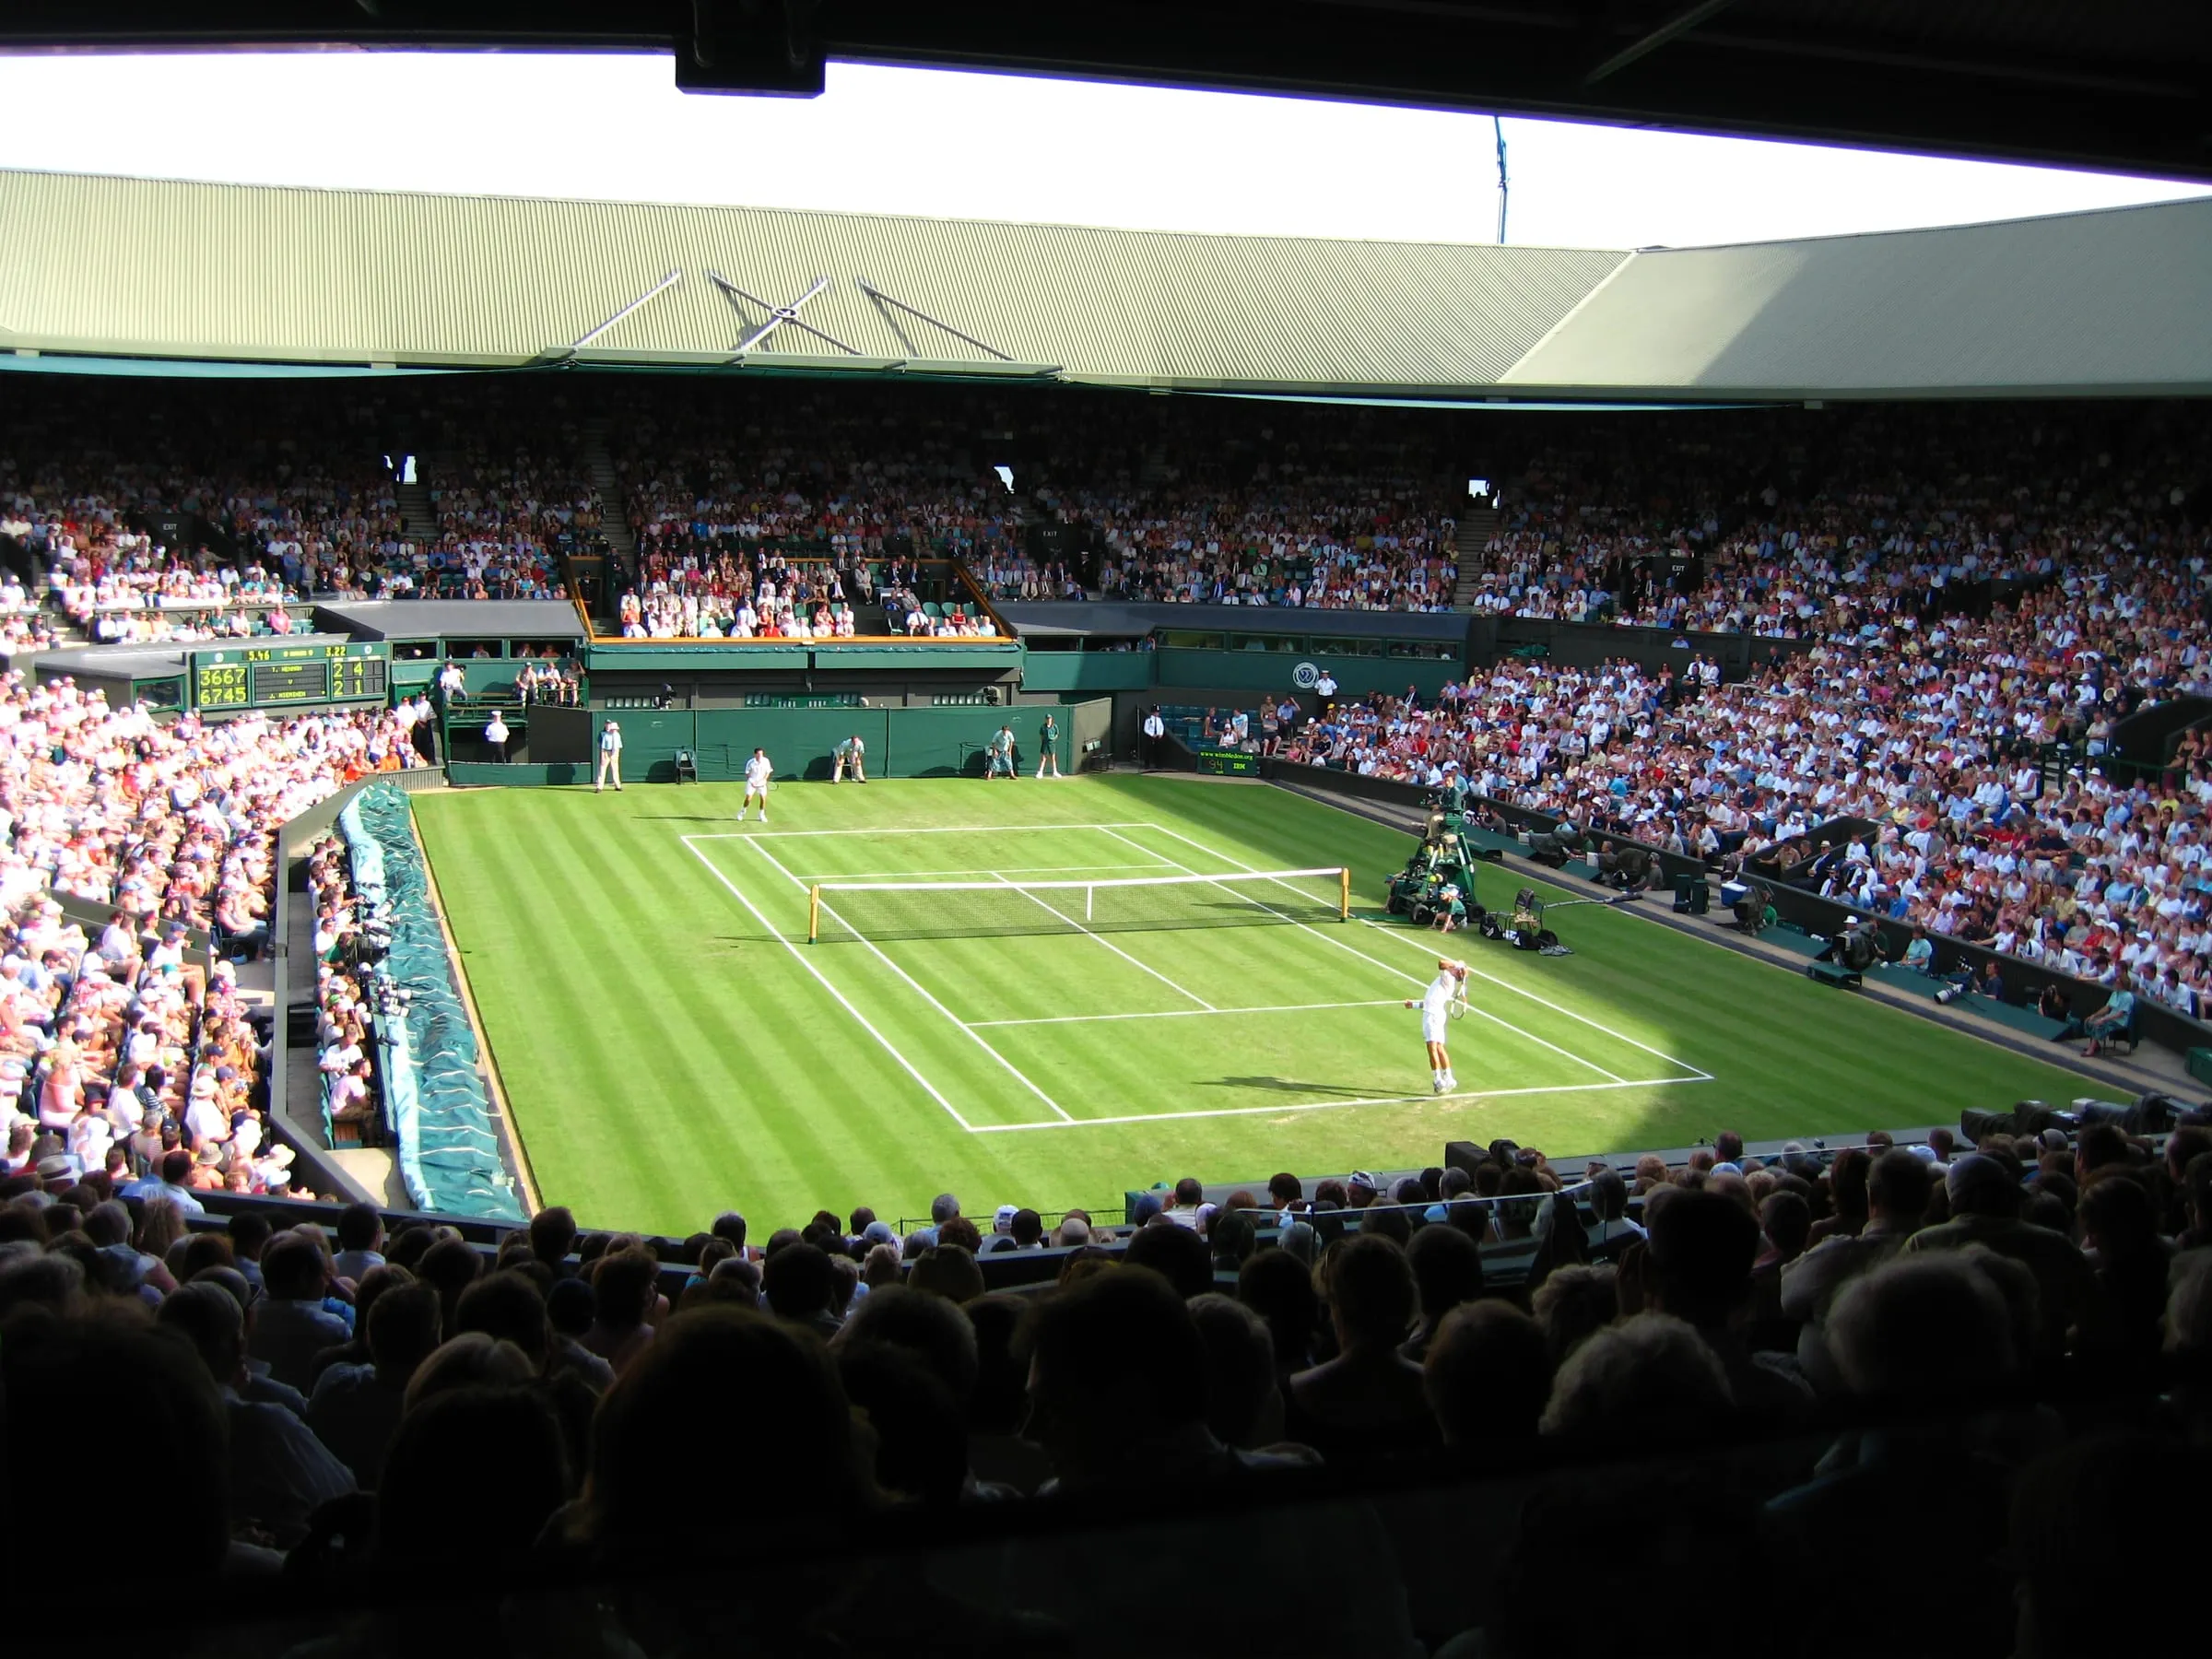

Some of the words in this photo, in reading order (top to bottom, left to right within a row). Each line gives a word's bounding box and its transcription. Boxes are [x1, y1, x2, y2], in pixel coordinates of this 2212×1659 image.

[162, 523, 177, 531] EXIT
[333, 663, 344, 678] 2
[353, 661, 364, 677] 4
[333, 680, 344, 696] 2
[354, 679, 363, 695] 1
